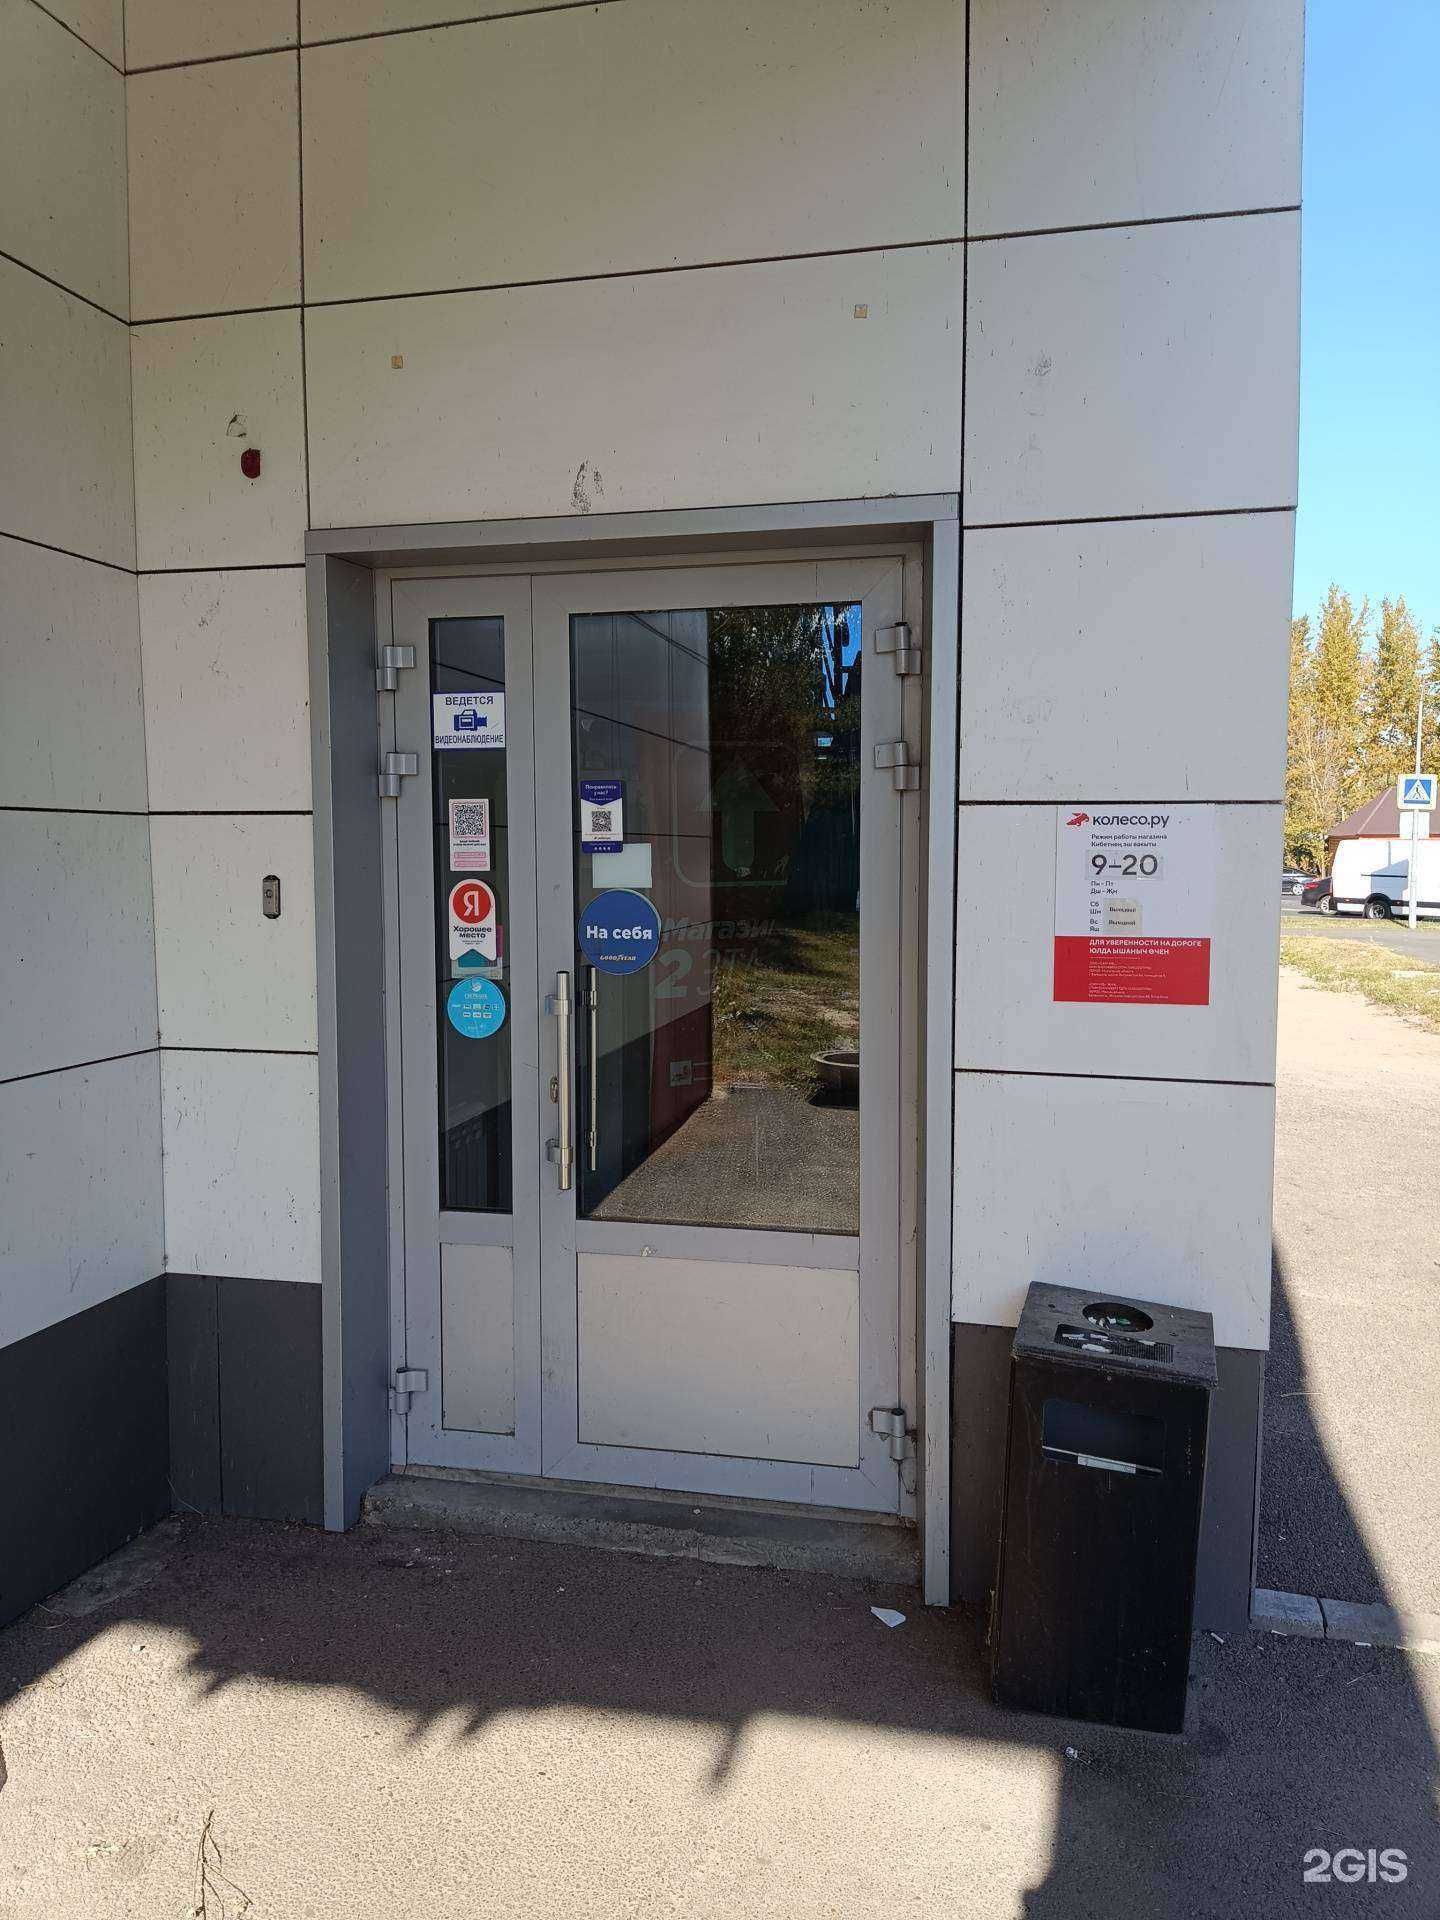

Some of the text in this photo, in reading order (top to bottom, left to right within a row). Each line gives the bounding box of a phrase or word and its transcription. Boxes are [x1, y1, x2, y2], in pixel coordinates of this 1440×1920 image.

[445, 696, 494, 706] ВЕДЕТСЯ
[435, 735, 504, 745] ВИДЕОНАБЛЮДЕНИЕ
[1092, 815, 1170, 828] колесо.ру
[1113, 833, 1138, 841] работы
[463, 890, 480, 917] Я
[453, 925, 493, 933] Хорошее
[586, 925, 652, 940] На себя
[1105, 939, 1159, 947] УВЕРЕННОСТИ
[1170, 940, 1203, 948] ДОРОГЕ
[1089, 947, 1113, 955] ЮЛДА
